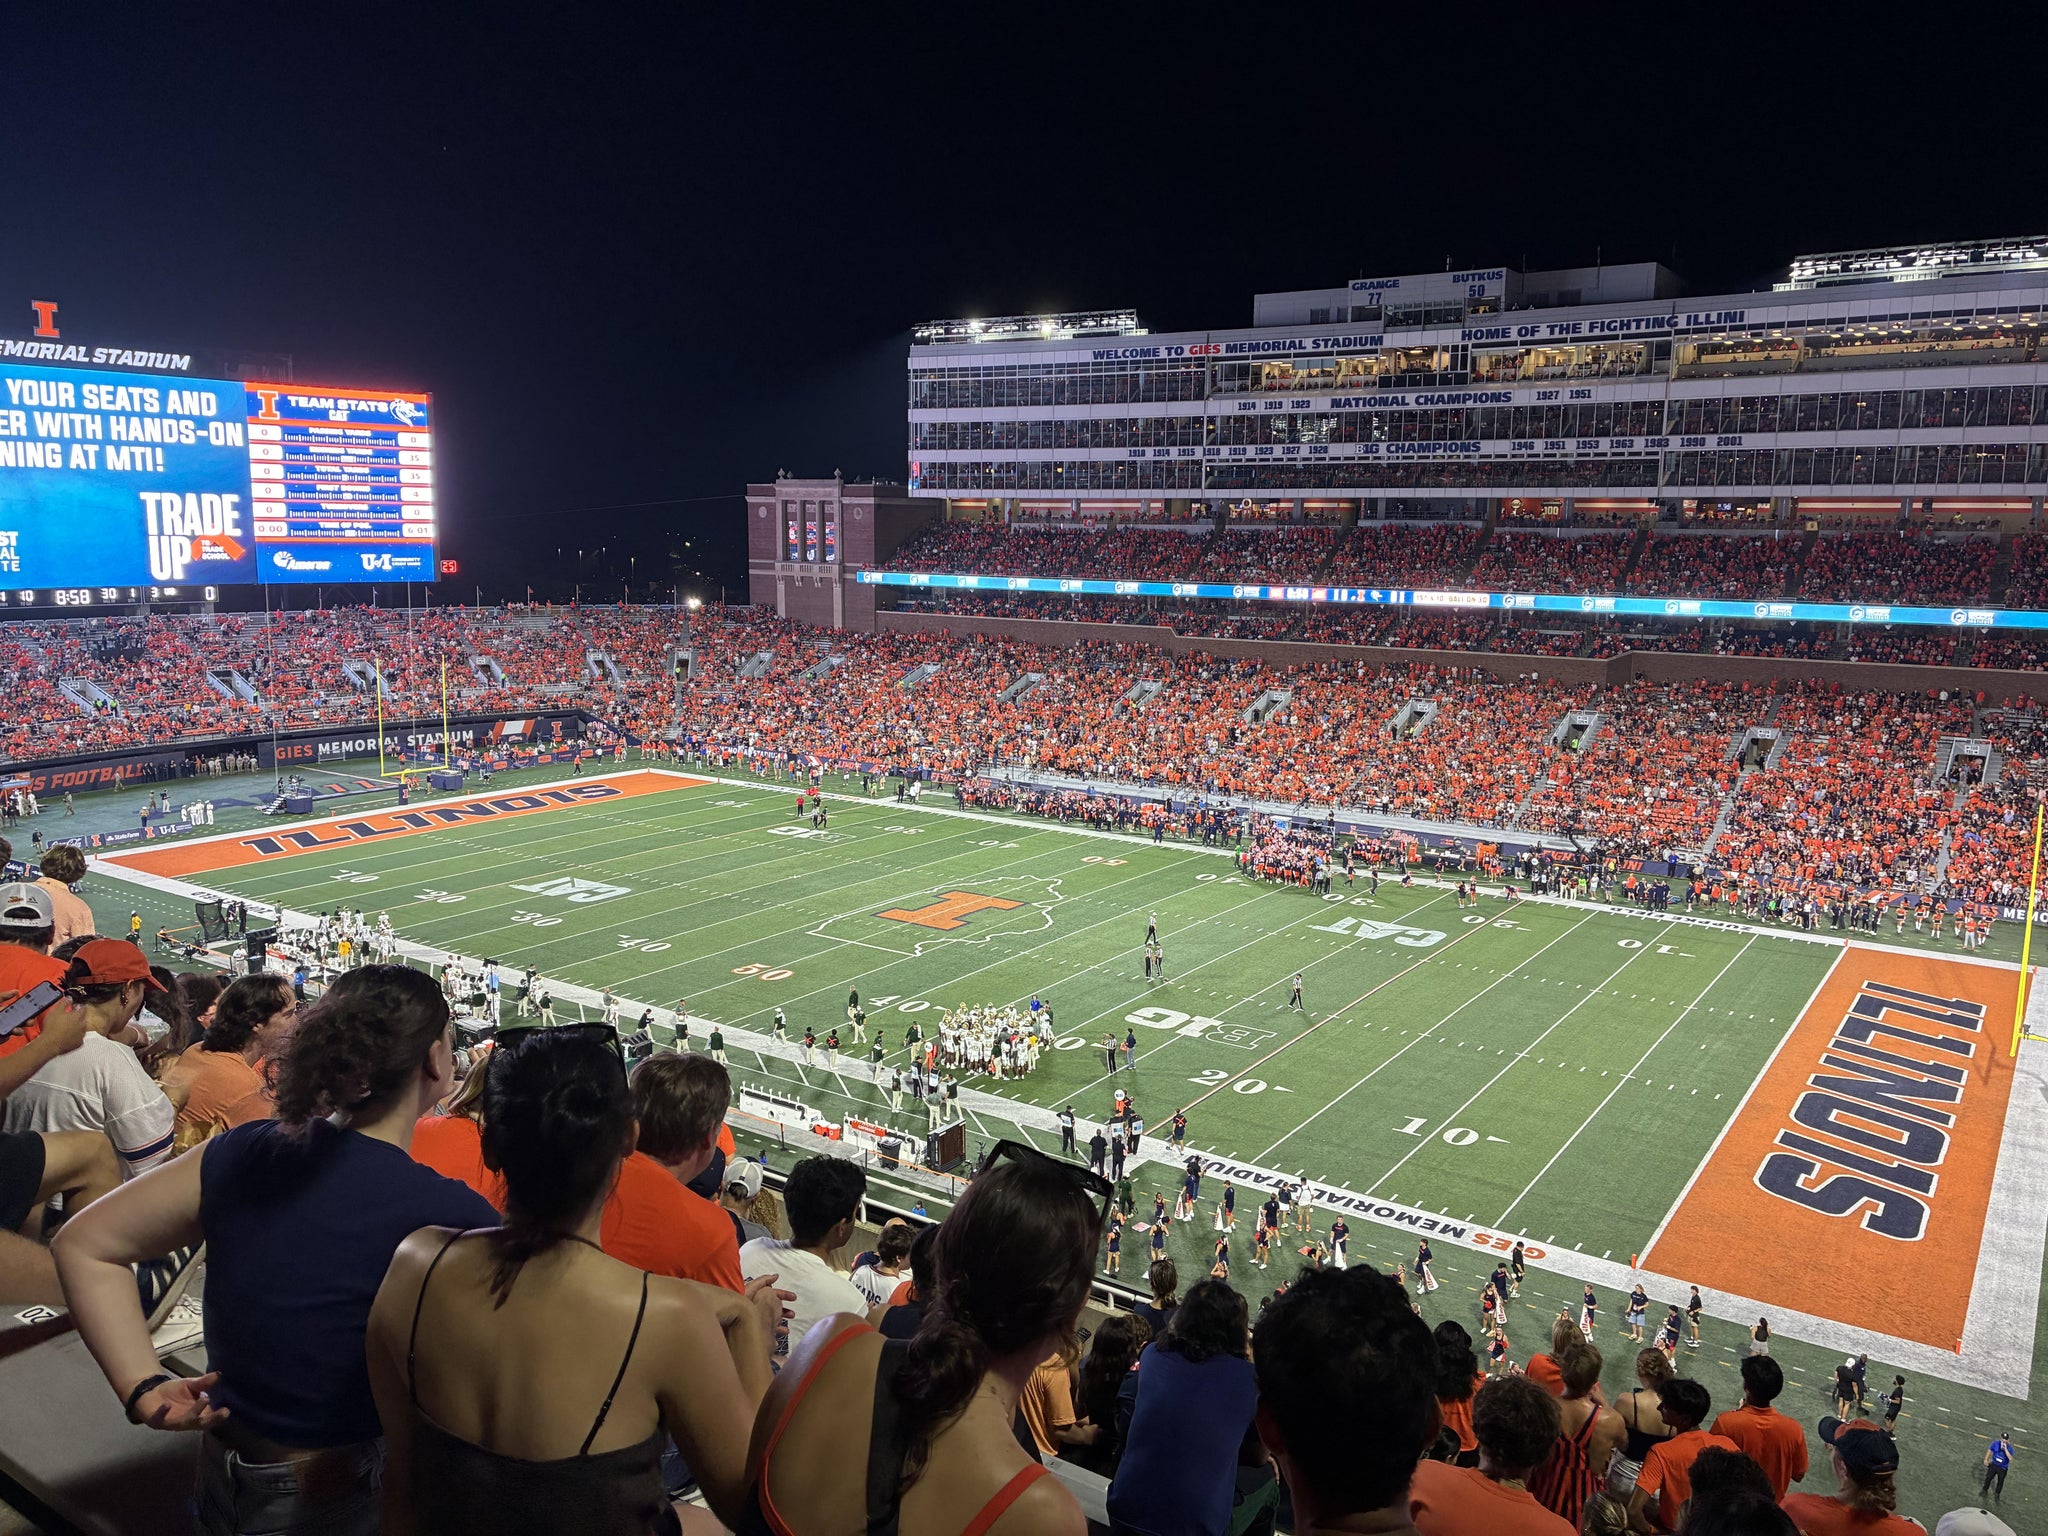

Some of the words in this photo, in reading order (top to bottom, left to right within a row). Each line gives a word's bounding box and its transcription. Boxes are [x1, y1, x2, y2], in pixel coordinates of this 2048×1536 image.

[1352, 280, 1400, 290] GRANGE
[1453, 271, 1503, 283] BUTKUS
[1368, 293, 1383, 304] 77
[1469, 285, 1486, 297] 50
[1461, 327, 1511, 341] HOME
[1517, 325, 1540, 337] OF
[1547, 322, 1582, 335] THE
[1588, 315, 1678, 333] FIGHTING
[1686, 310, 1745, 326] ILLINI
[93, 347, 191, 371] STADIUM
[1092, 347, 1160, 360] WELCOME
[1165, 345, 1184, 357] TO
[1189, 344, 1221, 355] GIES
[1225, 340, 1307, 354] MEMORIAL
[1312, 335, 1384, 348] STADIUM
[6, 378, 75, 407] YOUR
[82, 384, 160, 413] SEATS
[167, 390, 217, 416] AND
[287, 396, 335, 409] TEAM
[337, 400, 389, 412] STATS
[1238, 402, 1256, 411] 1914
[1264, 401, 1283, 410] 1919
[1290, 400, 1310, 409] 1923
[1331, 394, 1409, 408] NATIONAL
[1414, 391, 1512, 405] CHAMPIONS
[1536, 391, 1559, 400] 1927
[1569, 389, 1592, 399] 1951
[33, 411, 102, 440] WITH
[110, 415, 244, 446] HANDS-ON
[70, 444, 99, 470] AT
[106, 445, 164, 472] MTI!
[1153, 448, 1170, 457] 1914
[1254, 446, 1273, 455] 1923
[1281, 446, 1300, 455] 1927
[1386, 441, 1481, 454] CHAMPIONS
[1512, 441, 1534, 450] 1946
[1544, 440, 1566, 450] 1951
[1576, 440, 1599, 449] 1953
[1610, 439, 1634, 448] 1963
[1644, 438, 1669, 448] 1983
[1680, 437, 1706, 447] 1990
[1717, 436, 1743, 446] 2001
[140, 491, 242, 537] TRADE
[149, 535, 191, 581] UP
[20, 590, 34, 602] 10
[55, 589, 90, 605] 8:58
[100, 588, 117, 599] 30
[151, 587, 159, 597] 3
[205, 586, 215, 600] 0
[276, 744, 313, 760] GIES
[318, 736, 399, 754] MEMORIAL
[407, 729, 475, 748] STADIUM
[51, 763, 144, 789] FOOTBALL
[241, 783, 624, 856] ILLINOIS
[511, 910, 563, 927] 30
[617, 934, 672, 953] 40
[731, 963, 795, 981] 50
[1187, 1069, 1268, 1095] 20
[1392, 1115, 1479, 1146] 10
[1753, 979, 1988, 1242] ILLINOIS
[1311, 1186, 1467, 1239] MEMORIAL
[1472, 1232, 1547, 1260] GES
